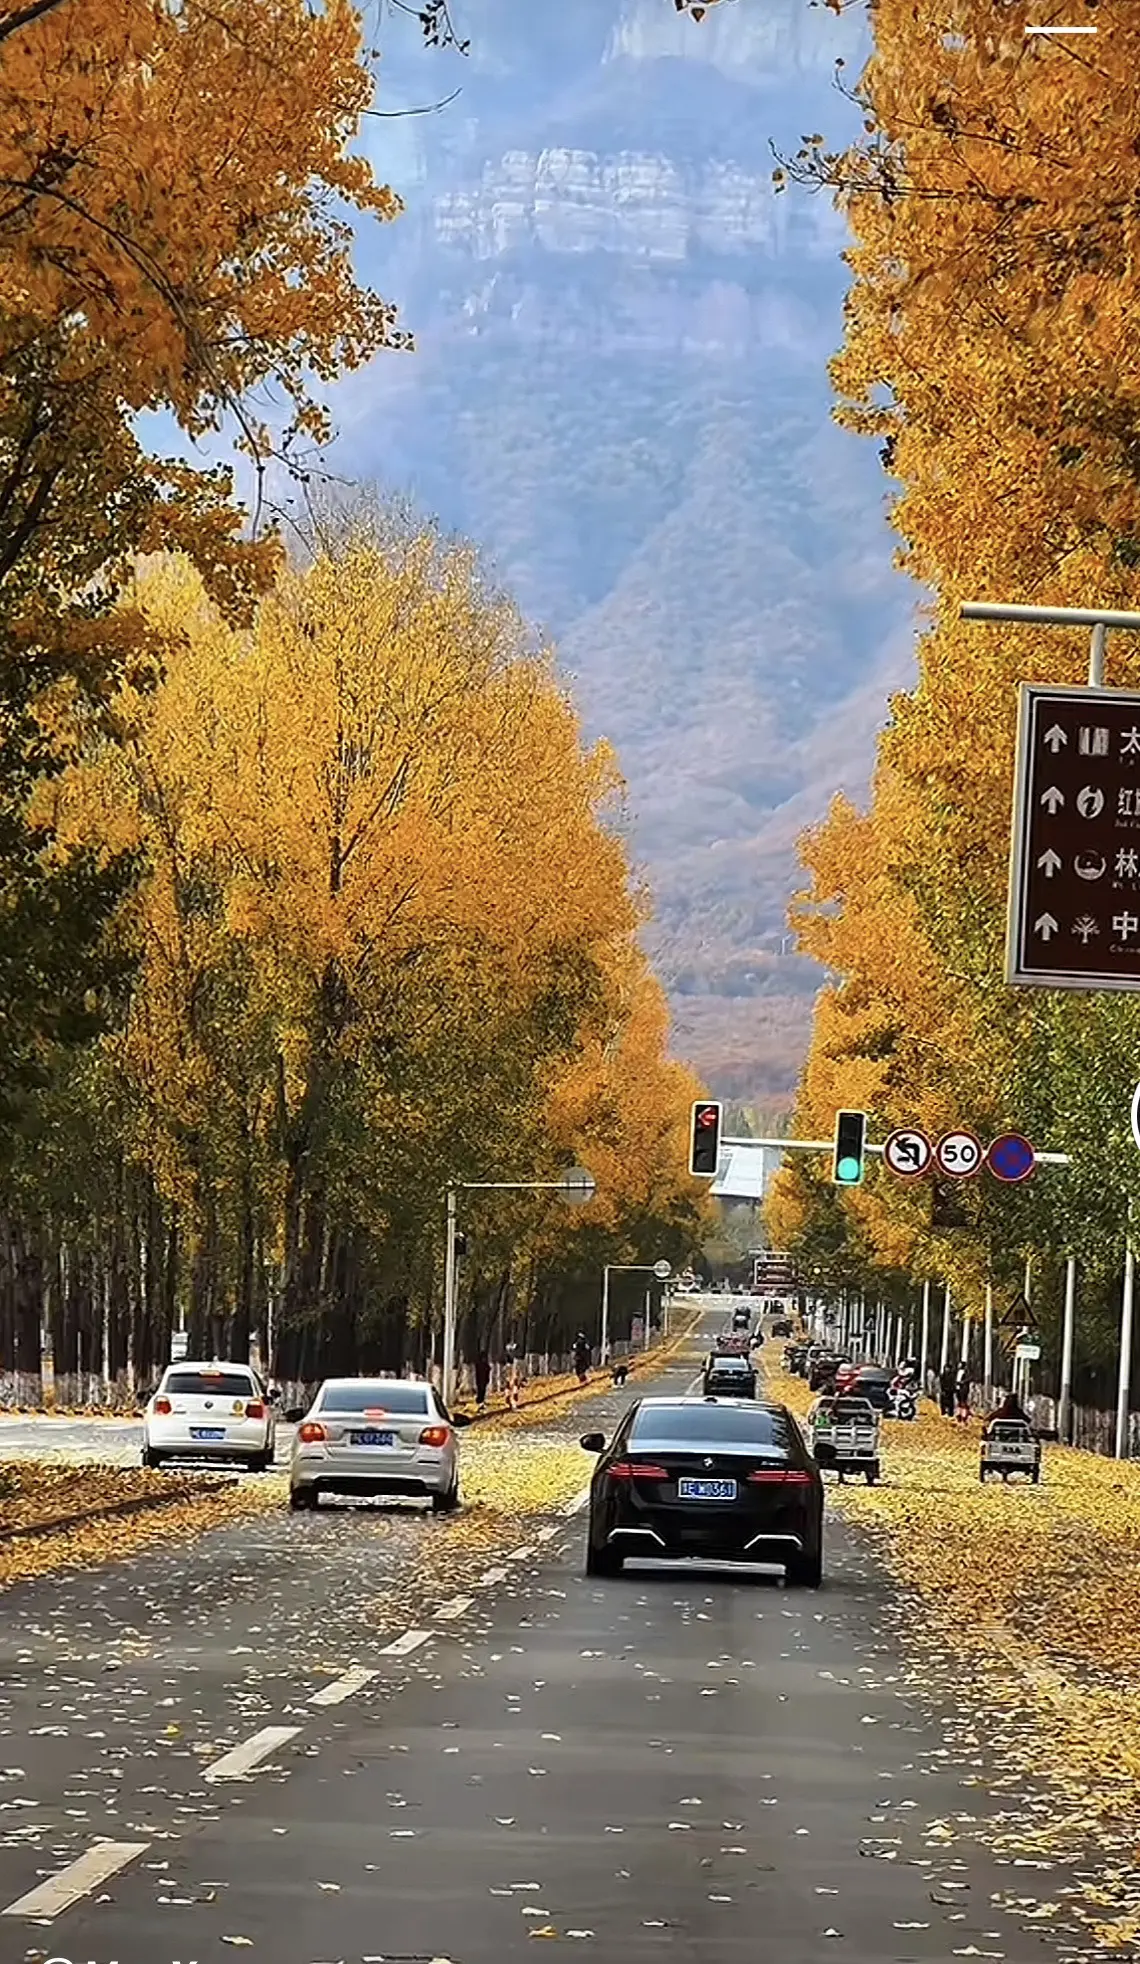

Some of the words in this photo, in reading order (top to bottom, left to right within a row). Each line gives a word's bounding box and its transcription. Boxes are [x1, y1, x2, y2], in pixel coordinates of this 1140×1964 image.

[1120, 726, 1140, 754] 太
[1114, 847, 1140, 878] 林
[1112, 911, 1139, 941] 中
[944, 1144, 975, 1163] 50
